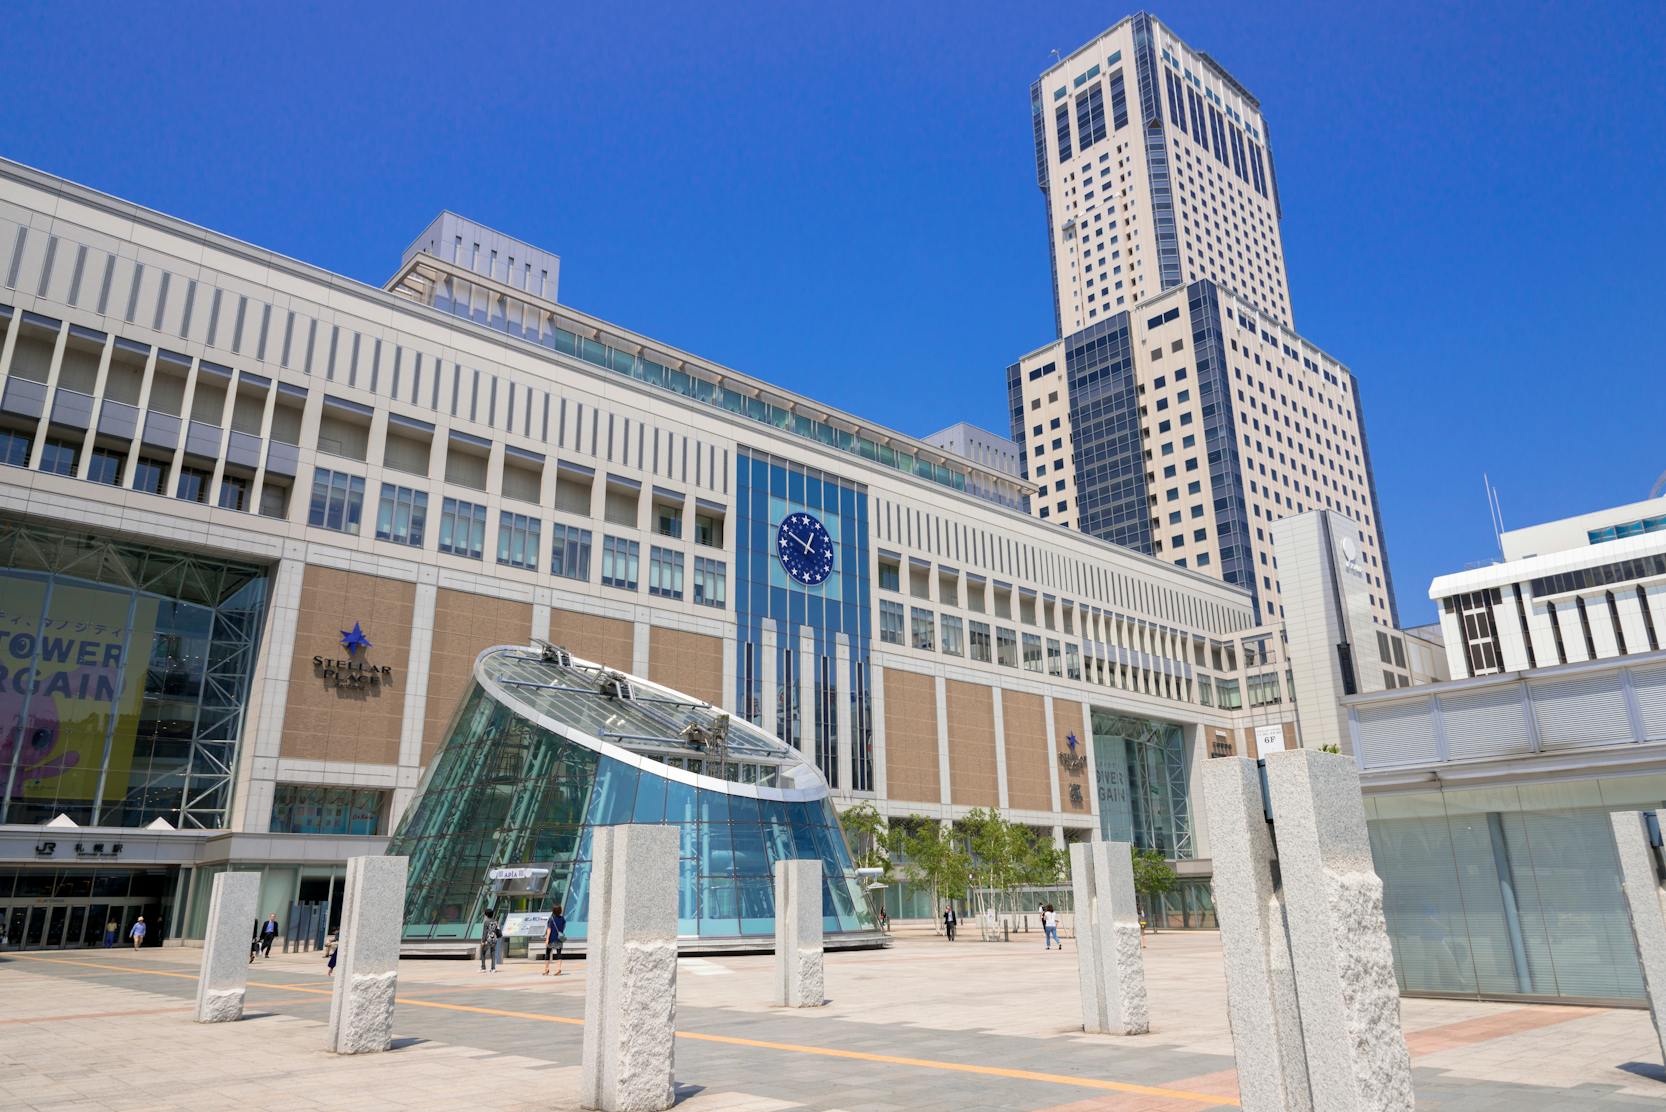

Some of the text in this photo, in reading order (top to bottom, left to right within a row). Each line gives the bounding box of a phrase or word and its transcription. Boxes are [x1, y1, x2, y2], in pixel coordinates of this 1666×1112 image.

[312, 655, 392, 674] STELLAR
[323, 669, 381, 685] PLACE
[1264, 735, 1276, 744] 6F
[35, 842, 56, 852] JR
